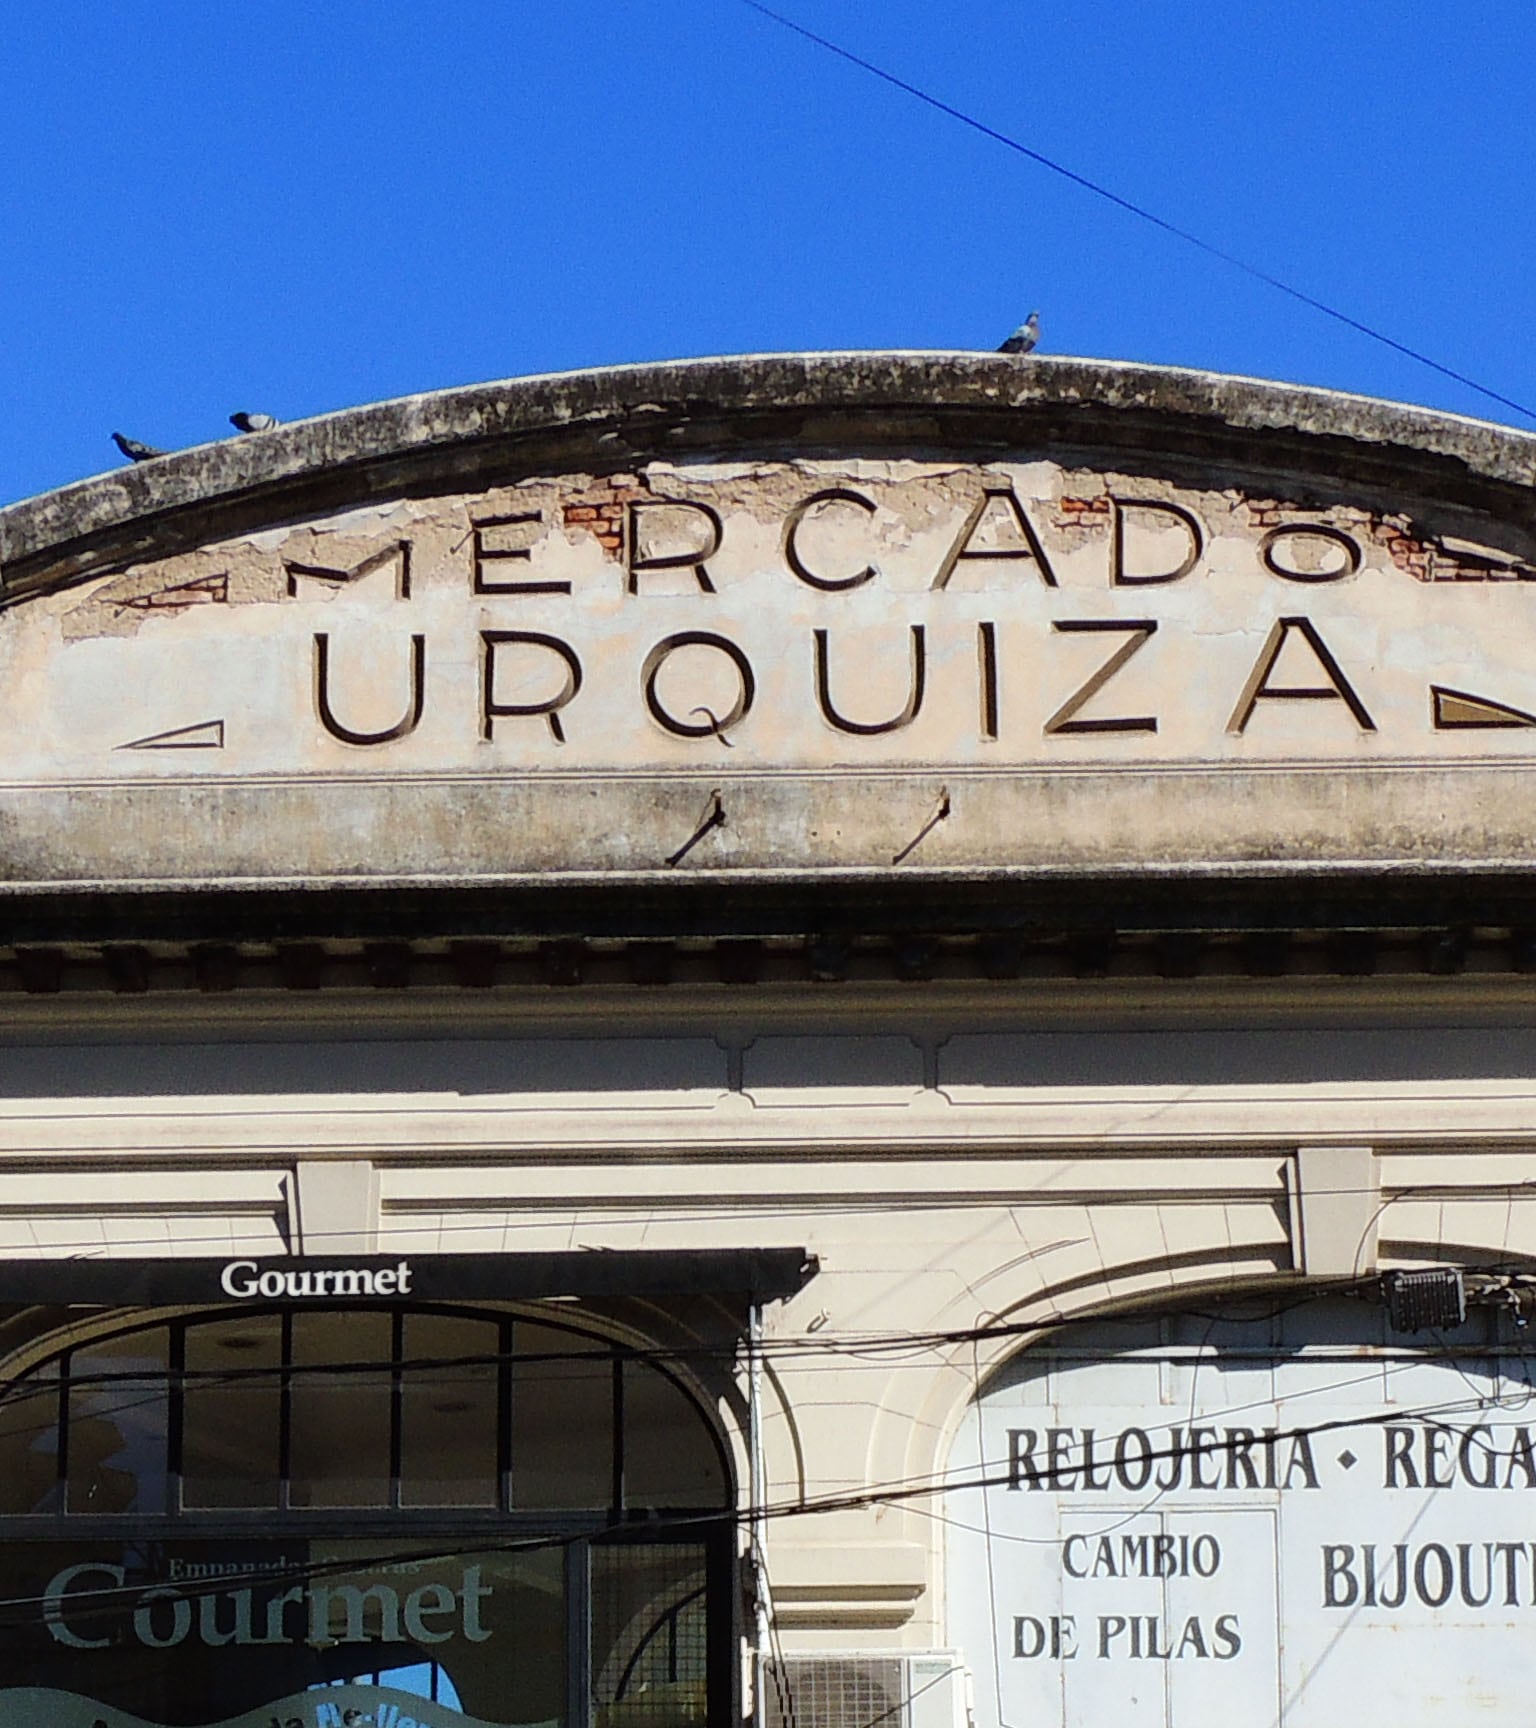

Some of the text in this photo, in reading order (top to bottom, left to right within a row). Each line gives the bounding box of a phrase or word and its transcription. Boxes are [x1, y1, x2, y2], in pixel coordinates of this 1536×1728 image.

[287, 486, 1365, 599] MERCADO
[313, 615, 1379, 747] URQUIZA
[220, 1260, 413, 1298] Gourmet
[1006, 1426, 1321, 1492] RELOJERIA
[1062, 1533, 1222, 1579] CAMBIO
[42, 1562, 494, 1650] Gourmet
[1012, 1614, 1242, 1660] DE PILAS
